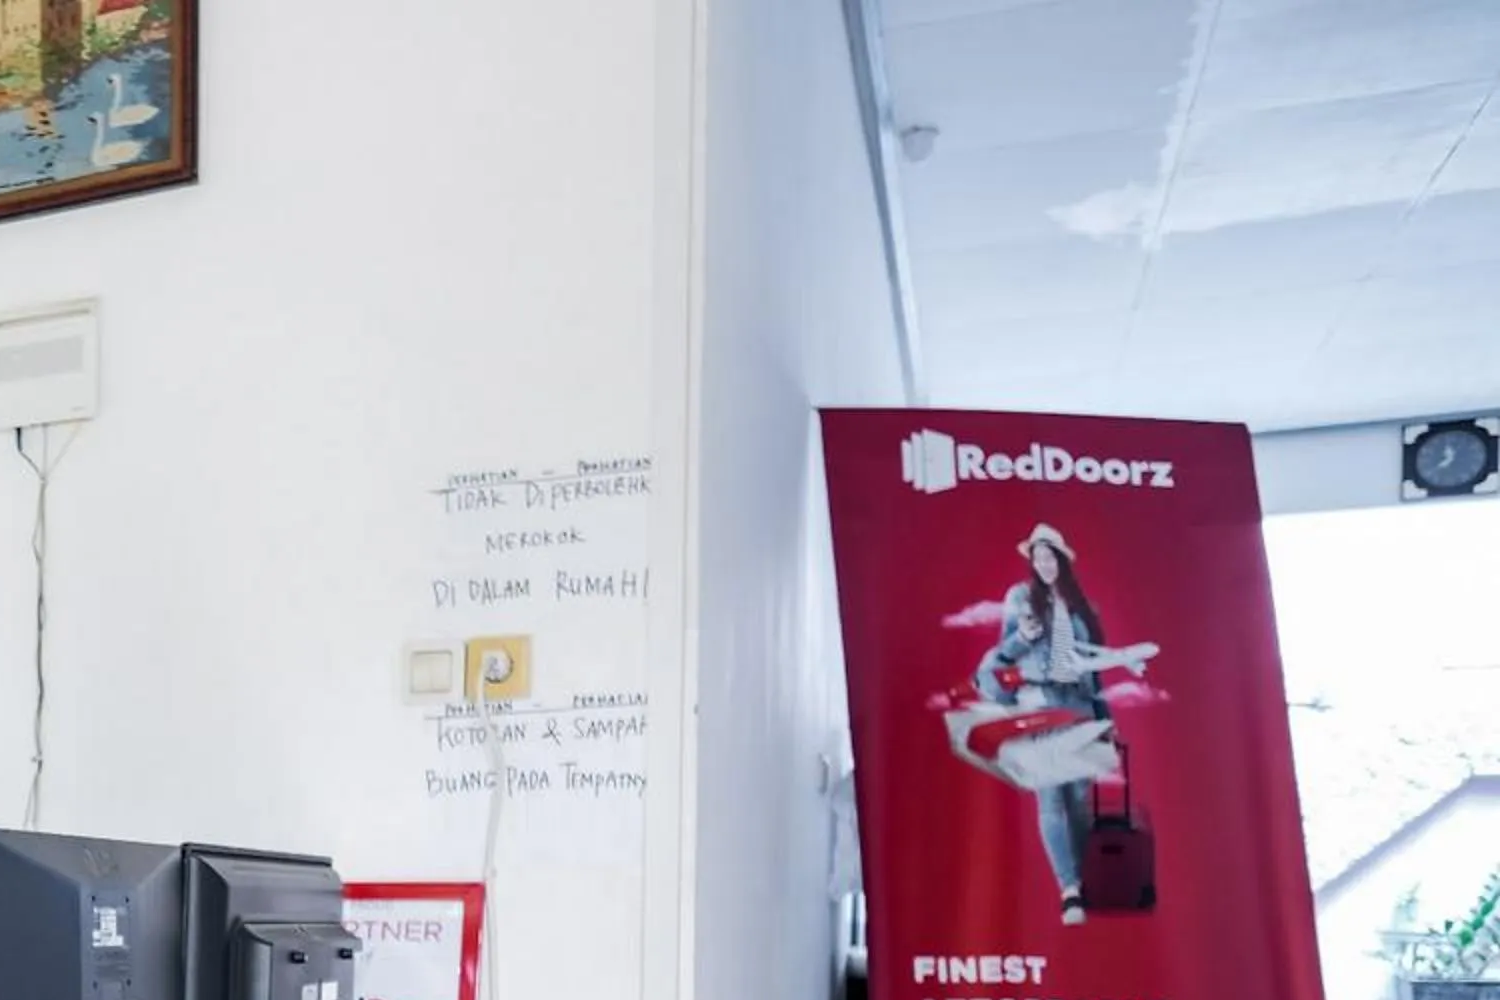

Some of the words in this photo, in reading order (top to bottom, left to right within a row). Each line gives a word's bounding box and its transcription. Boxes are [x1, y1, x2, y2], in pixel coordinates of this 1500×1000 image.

[957, 442, 1175, 489] RedDoorz
[484, 527, 587, 554] MEROKOK
[468, 577, 531, 605] DALAM
[437, 716, 528, 750] KOTOAN
[506, 764, 550, 799] PADA
[913, 955, 1048, 985] FINEST
